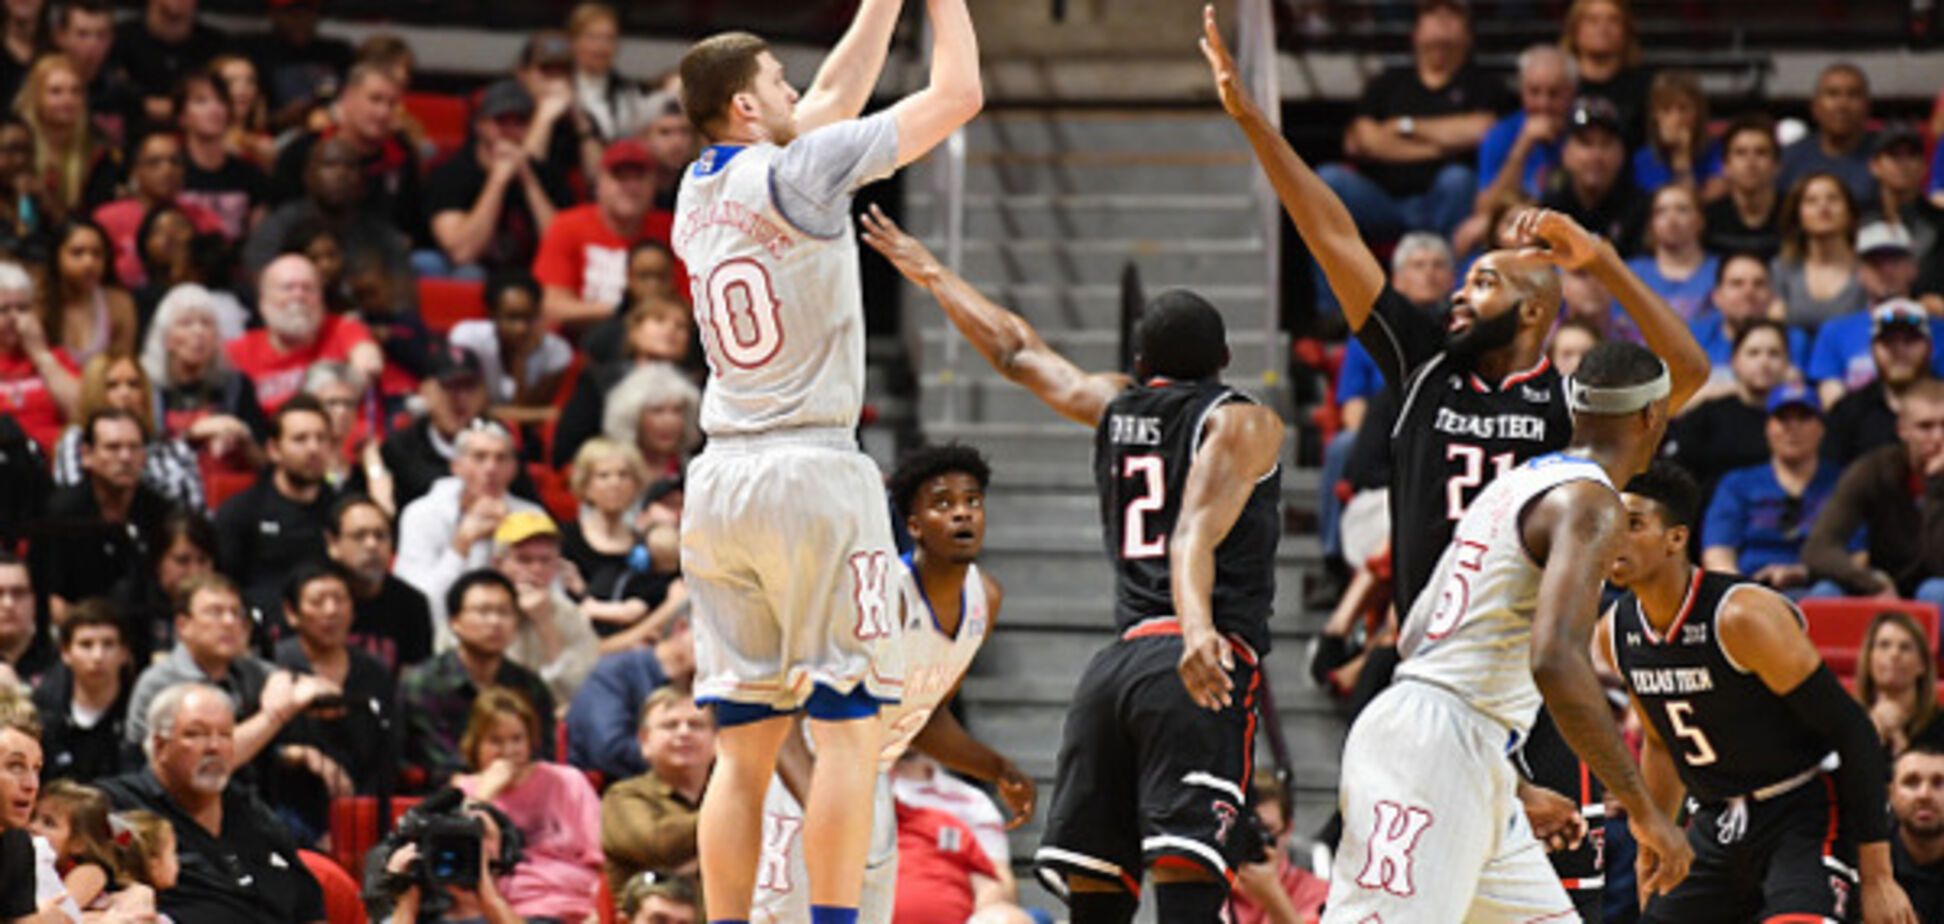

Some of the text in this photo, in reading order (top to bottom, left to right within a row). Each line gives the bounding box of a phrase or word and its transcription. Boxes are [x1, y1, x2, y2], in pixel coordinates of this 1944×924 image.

[1434, 407, 1546, 442] TEXAS TECH
[849, 551, 892, 641] K
[1630, 666, 1714, 694] TEXAS TECH
[1665, 701, 1719, 766] 5
[1355, 800, 1434, 898] K
